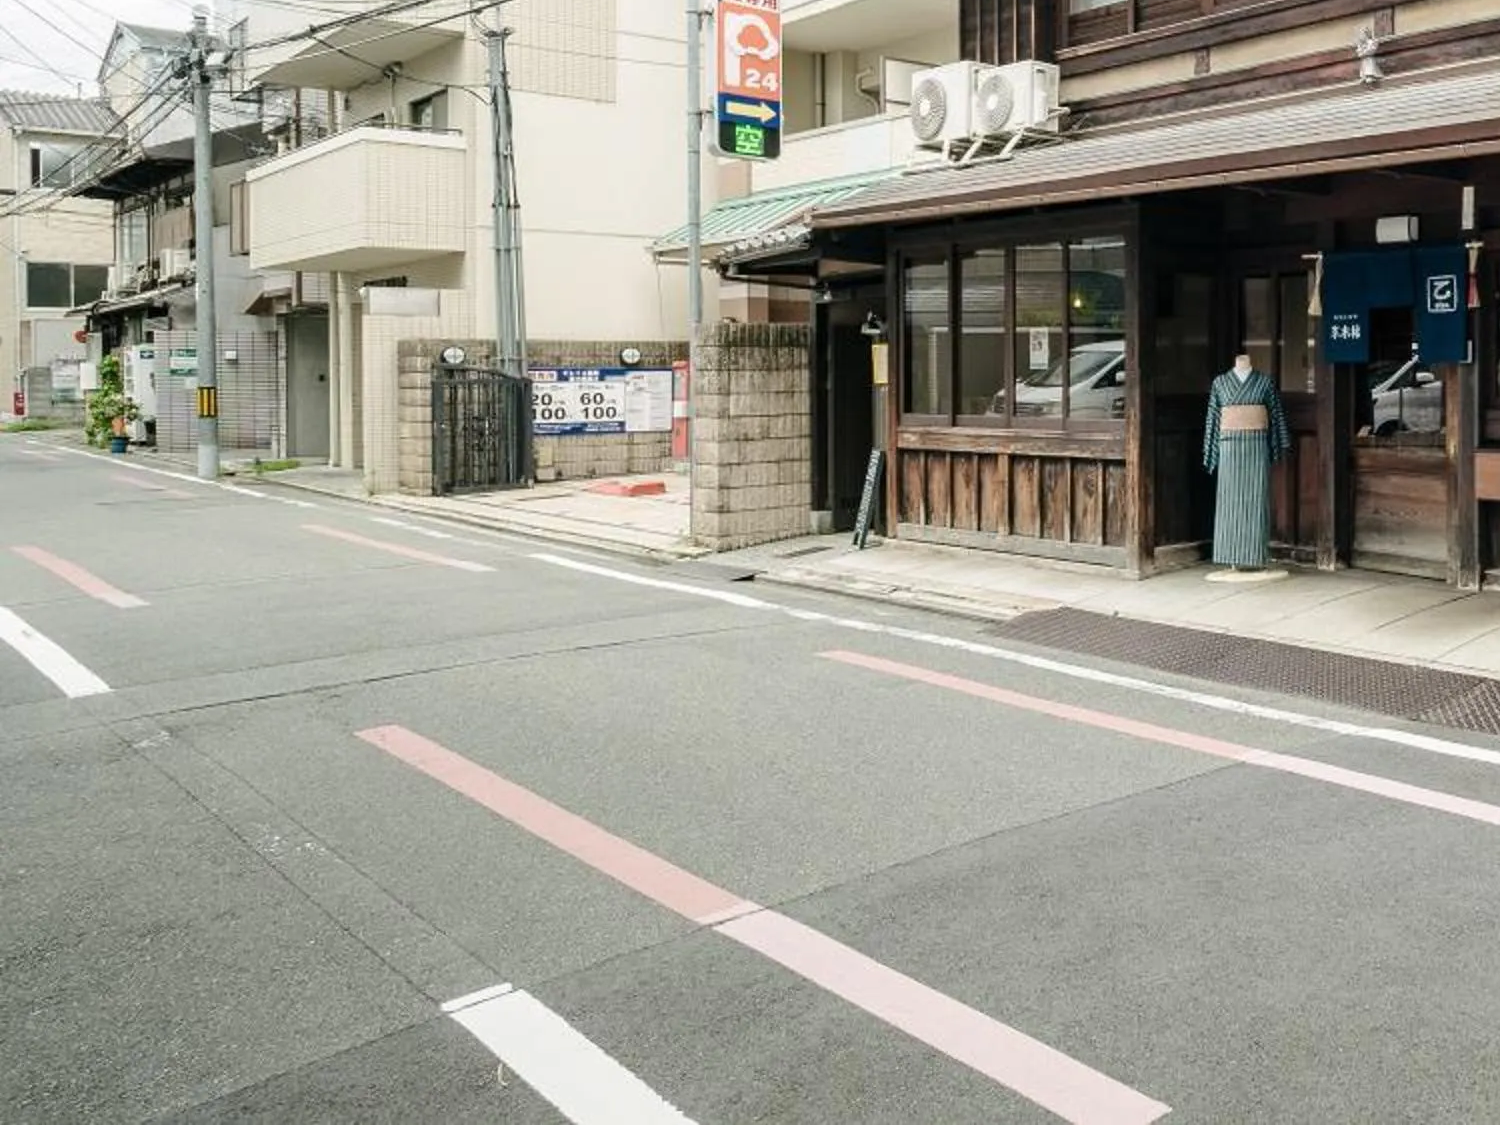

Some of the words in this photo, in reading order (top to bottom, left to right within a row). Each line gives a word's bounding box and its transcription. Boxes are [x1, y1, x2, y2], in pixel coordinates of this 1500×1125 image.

[745, 68, 778, 93] 24
[531, 392, 553, 406] 20
[580, 392, 604, 406] 60
[531, 407, 567, 420] 100
[582, 406, 617, 420] 100
